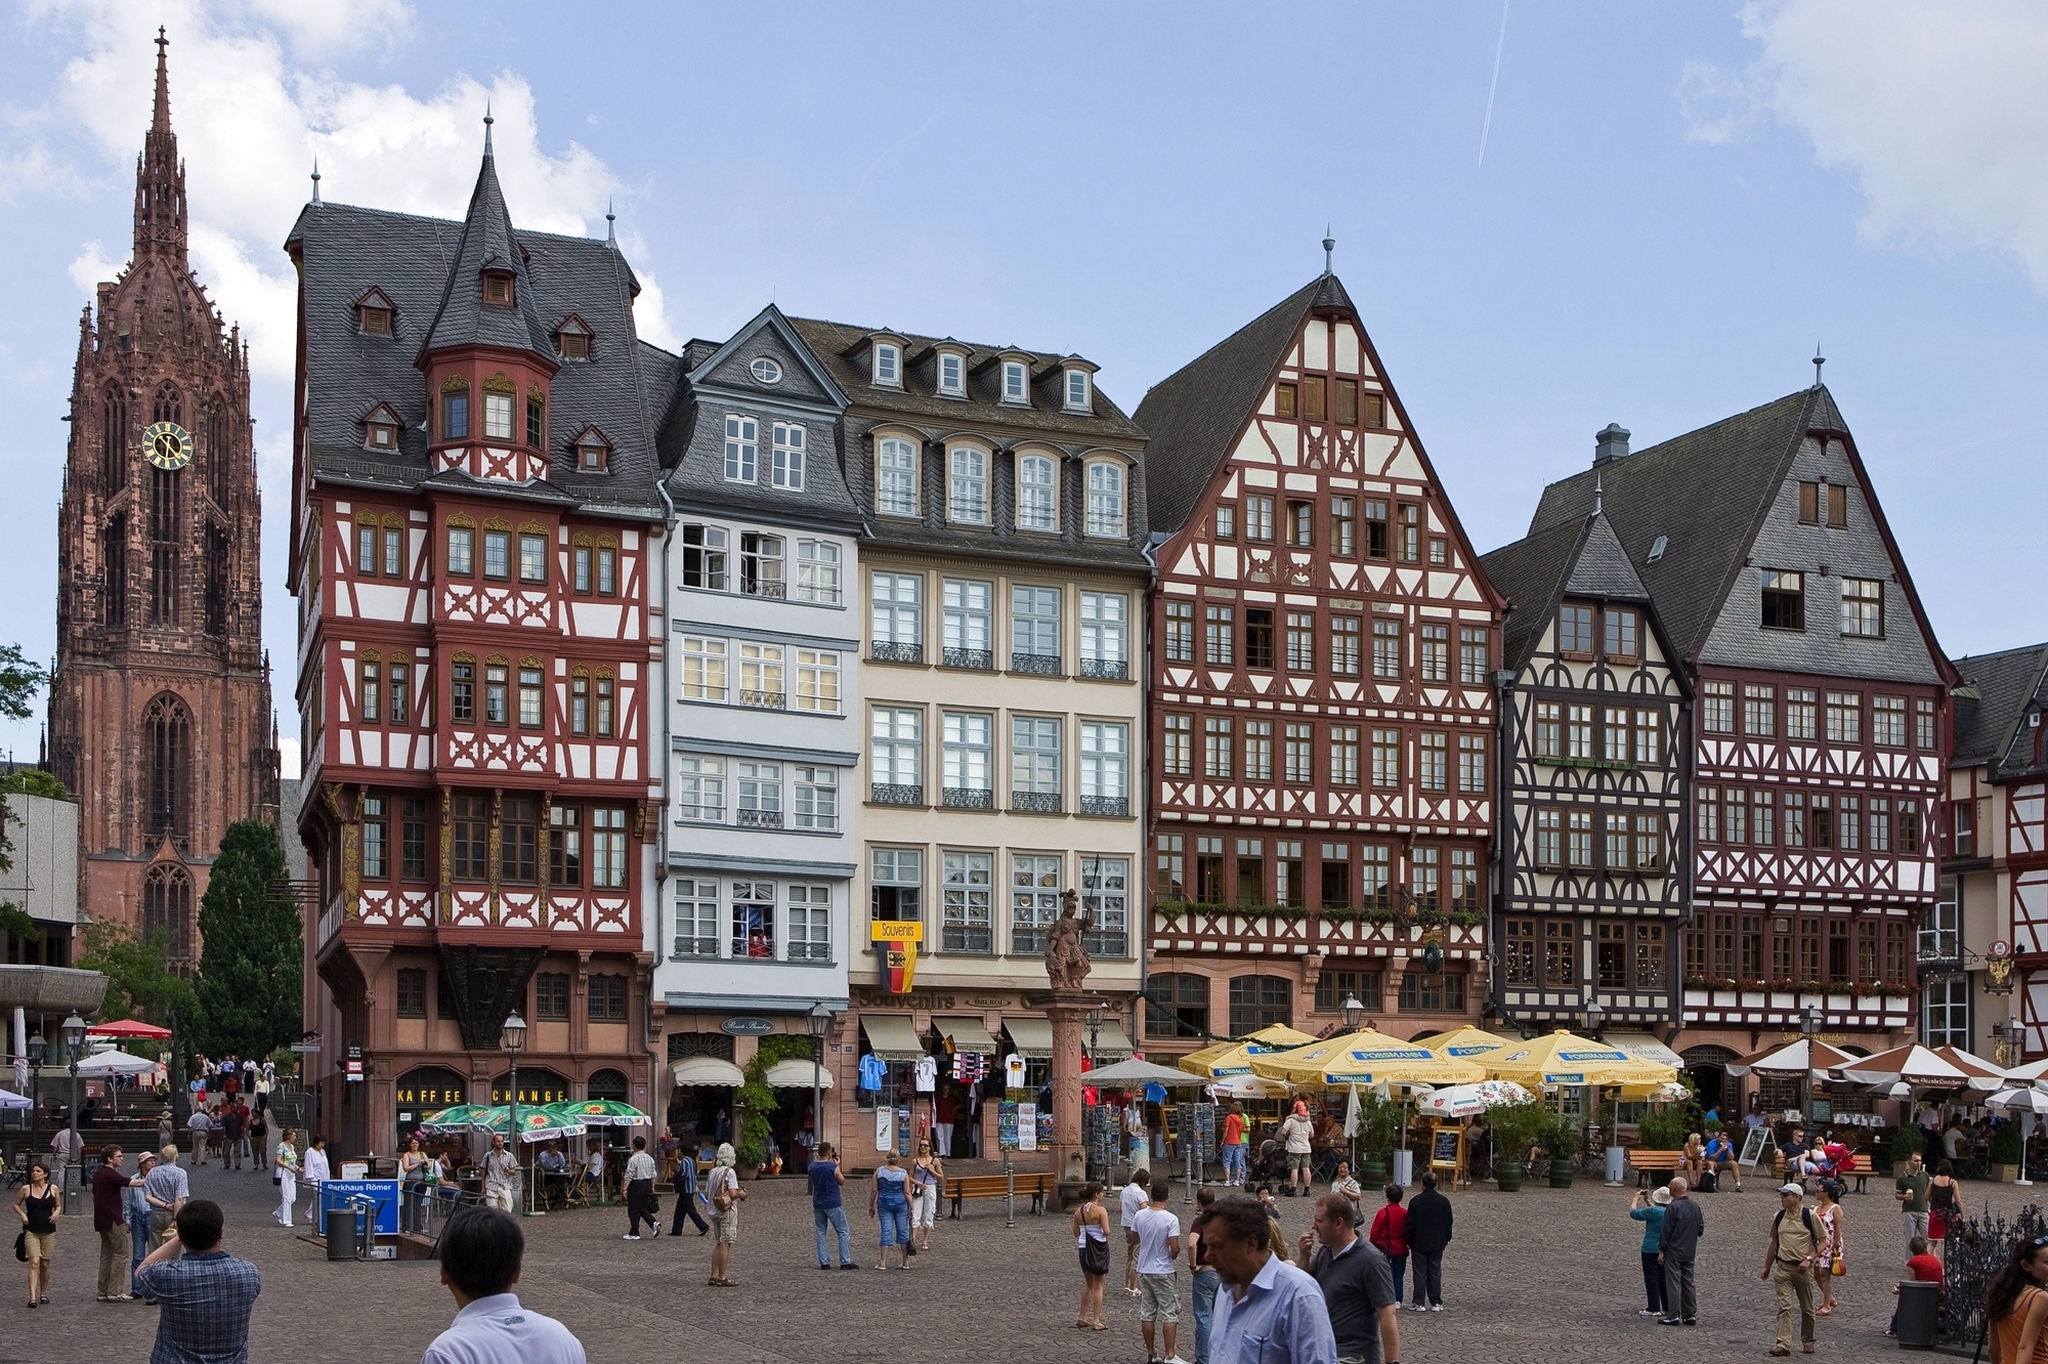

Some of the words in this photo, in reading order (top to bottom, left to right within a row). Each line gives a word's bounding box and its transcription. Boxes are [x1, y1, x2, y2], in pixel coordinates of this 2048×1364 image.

[881, 922, 914, 937] Souvenirs
[859, 988, 956, 1010] Souvenirs
[1361, 1051, 1424, 1060] POSSMANN
[1332, 1075, 1367, 1083] POSSMANN
[492, 1089, 565, 1102] CHANGE
[327, 1183, 365, 1192] Parkhaus
[365, 1183, 392, 1191] Römer
